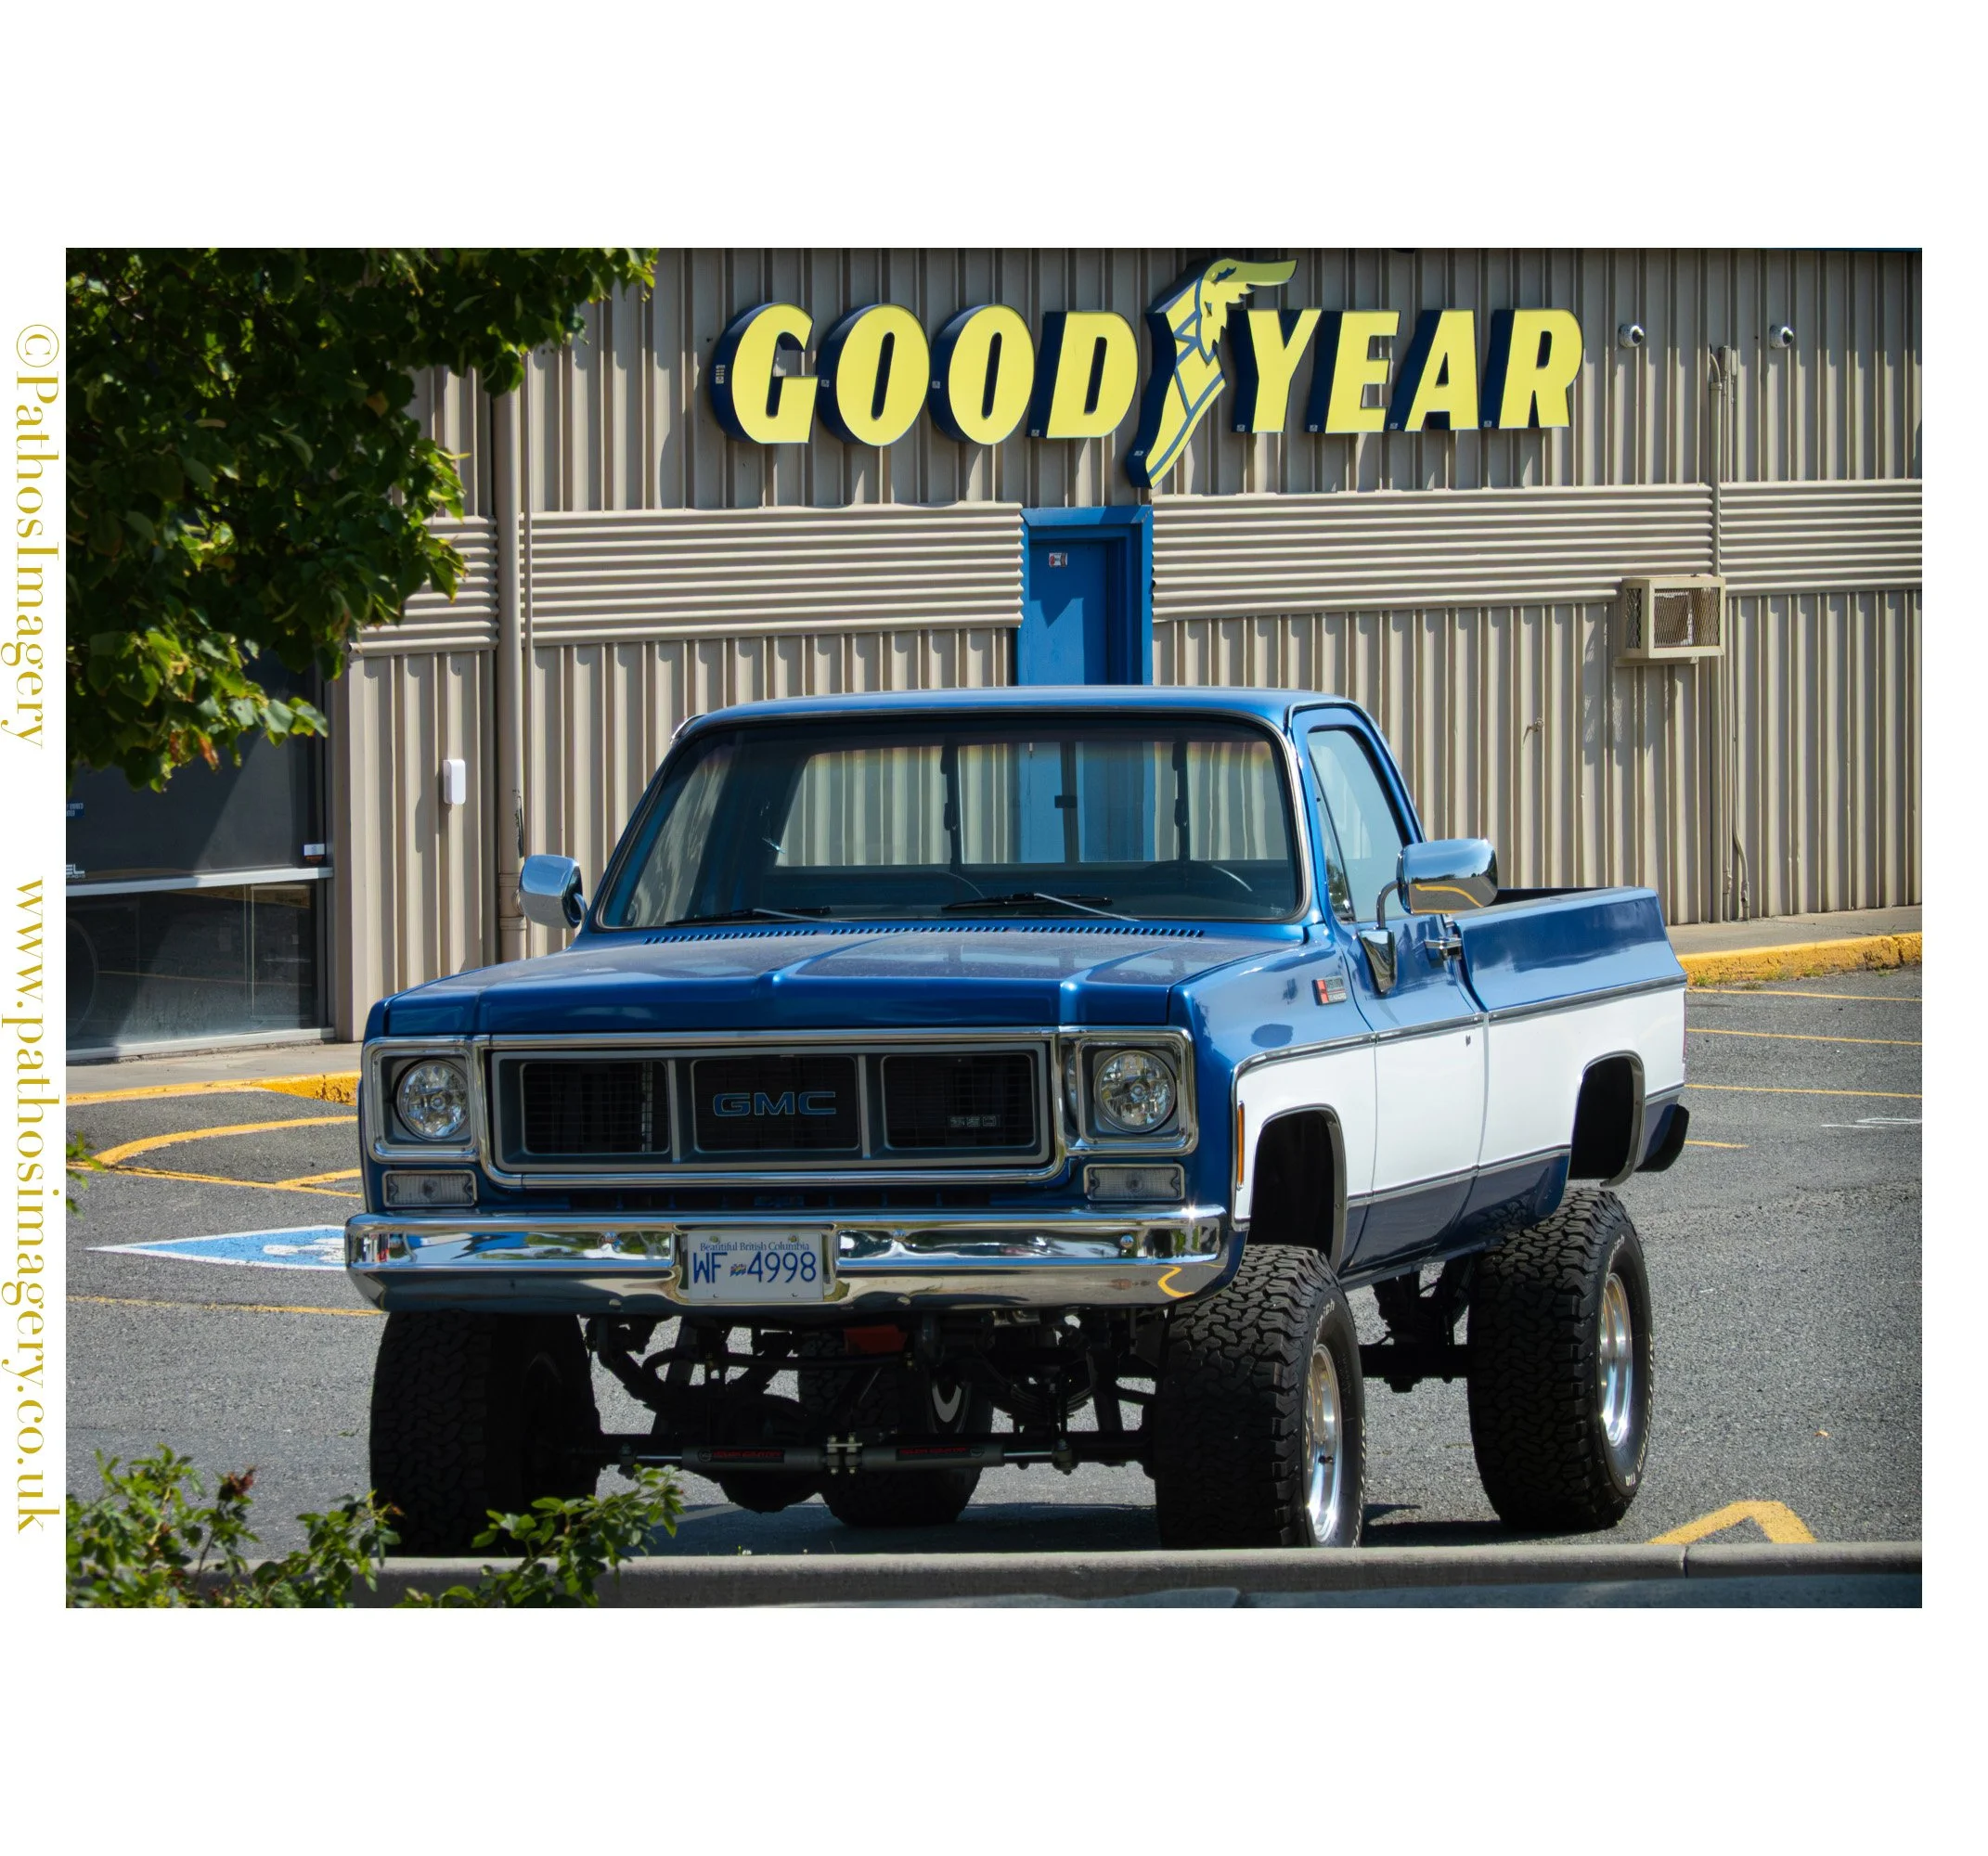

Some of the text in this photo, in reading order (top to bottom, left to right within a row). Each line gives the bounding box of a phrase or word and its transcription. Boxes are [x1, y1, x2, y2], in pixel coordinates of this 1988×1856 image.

[713, 1091, 836, 1116] GMC
[700, 1242, 810, 1251] Beautiful British Columbia
[693, 1251, 817, 1283] WF 4998
